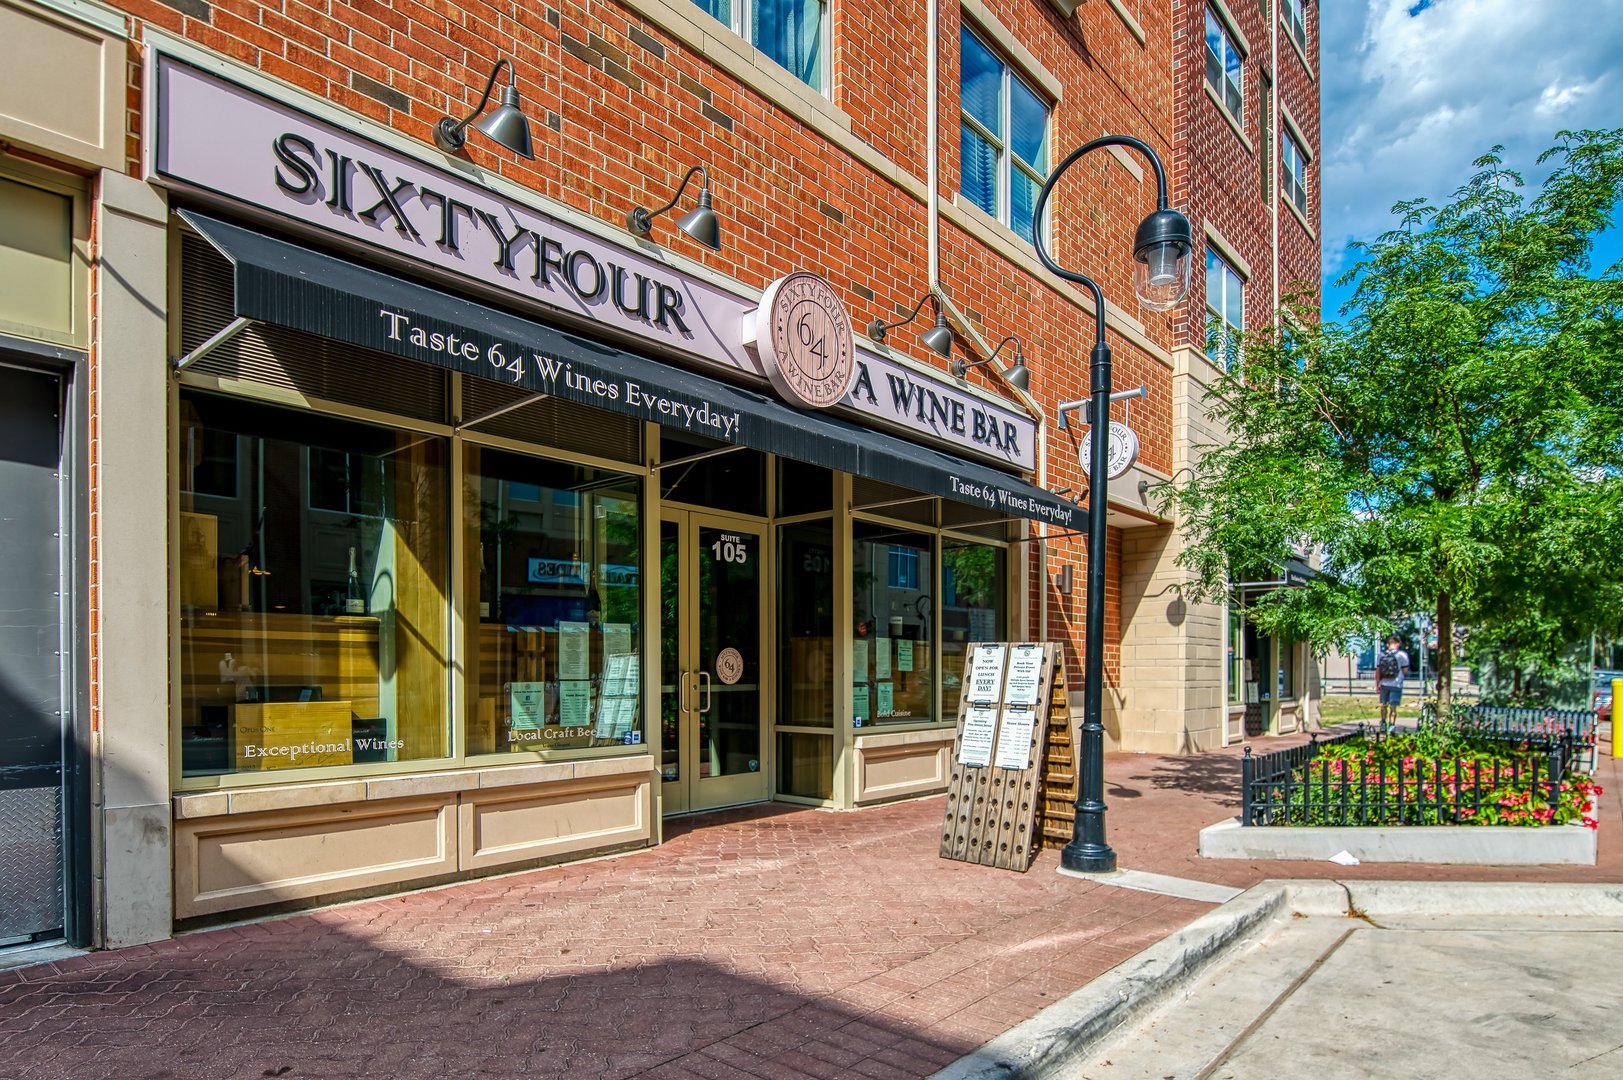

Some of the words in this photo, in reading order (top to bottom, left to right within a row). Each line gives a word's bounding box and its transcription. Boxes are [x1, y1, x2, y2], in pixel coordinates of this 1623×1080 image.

[274, 132, 692, 335] SIXTYFOUR
[780, 282, 845, 336] SIXTYFOUR
[797, 312, 829, 370] 64
[380, 309, 480, 361] Taste
[487, 343, 526, 382] 64
[533, 353, 619, 399] Wines
[625, 381, 740, 437] Everyday!
[778, 350, 789, 364] A
[788, 366, 823, 397] WINE
[824, 370, 845, 397] BAR
[852, 360, 877, 404] A
[886, 372, 966, 435] WINE
[971, 407, 1021, 455] BAR
[1113, 456, 1128, 471] BAR
[949, 475, 981, 499] Taste
[982, 485, 996, 508] 64
[997, 489, 1028, 510] Wines
[1029, 497, 1072, 526] Everyday!
[711, 541, 747, 564] 105
[720, 533, 741, 543] SUITE
[724, 659, 735, 673] 64
[244, 738, 351, 761] Exceptional
[355, 737, 405, 751] Wines
[507, 728, 542, 742] Local
[544, 725, 574, 740] Craft
[577, 727, 598, 738] Bee
